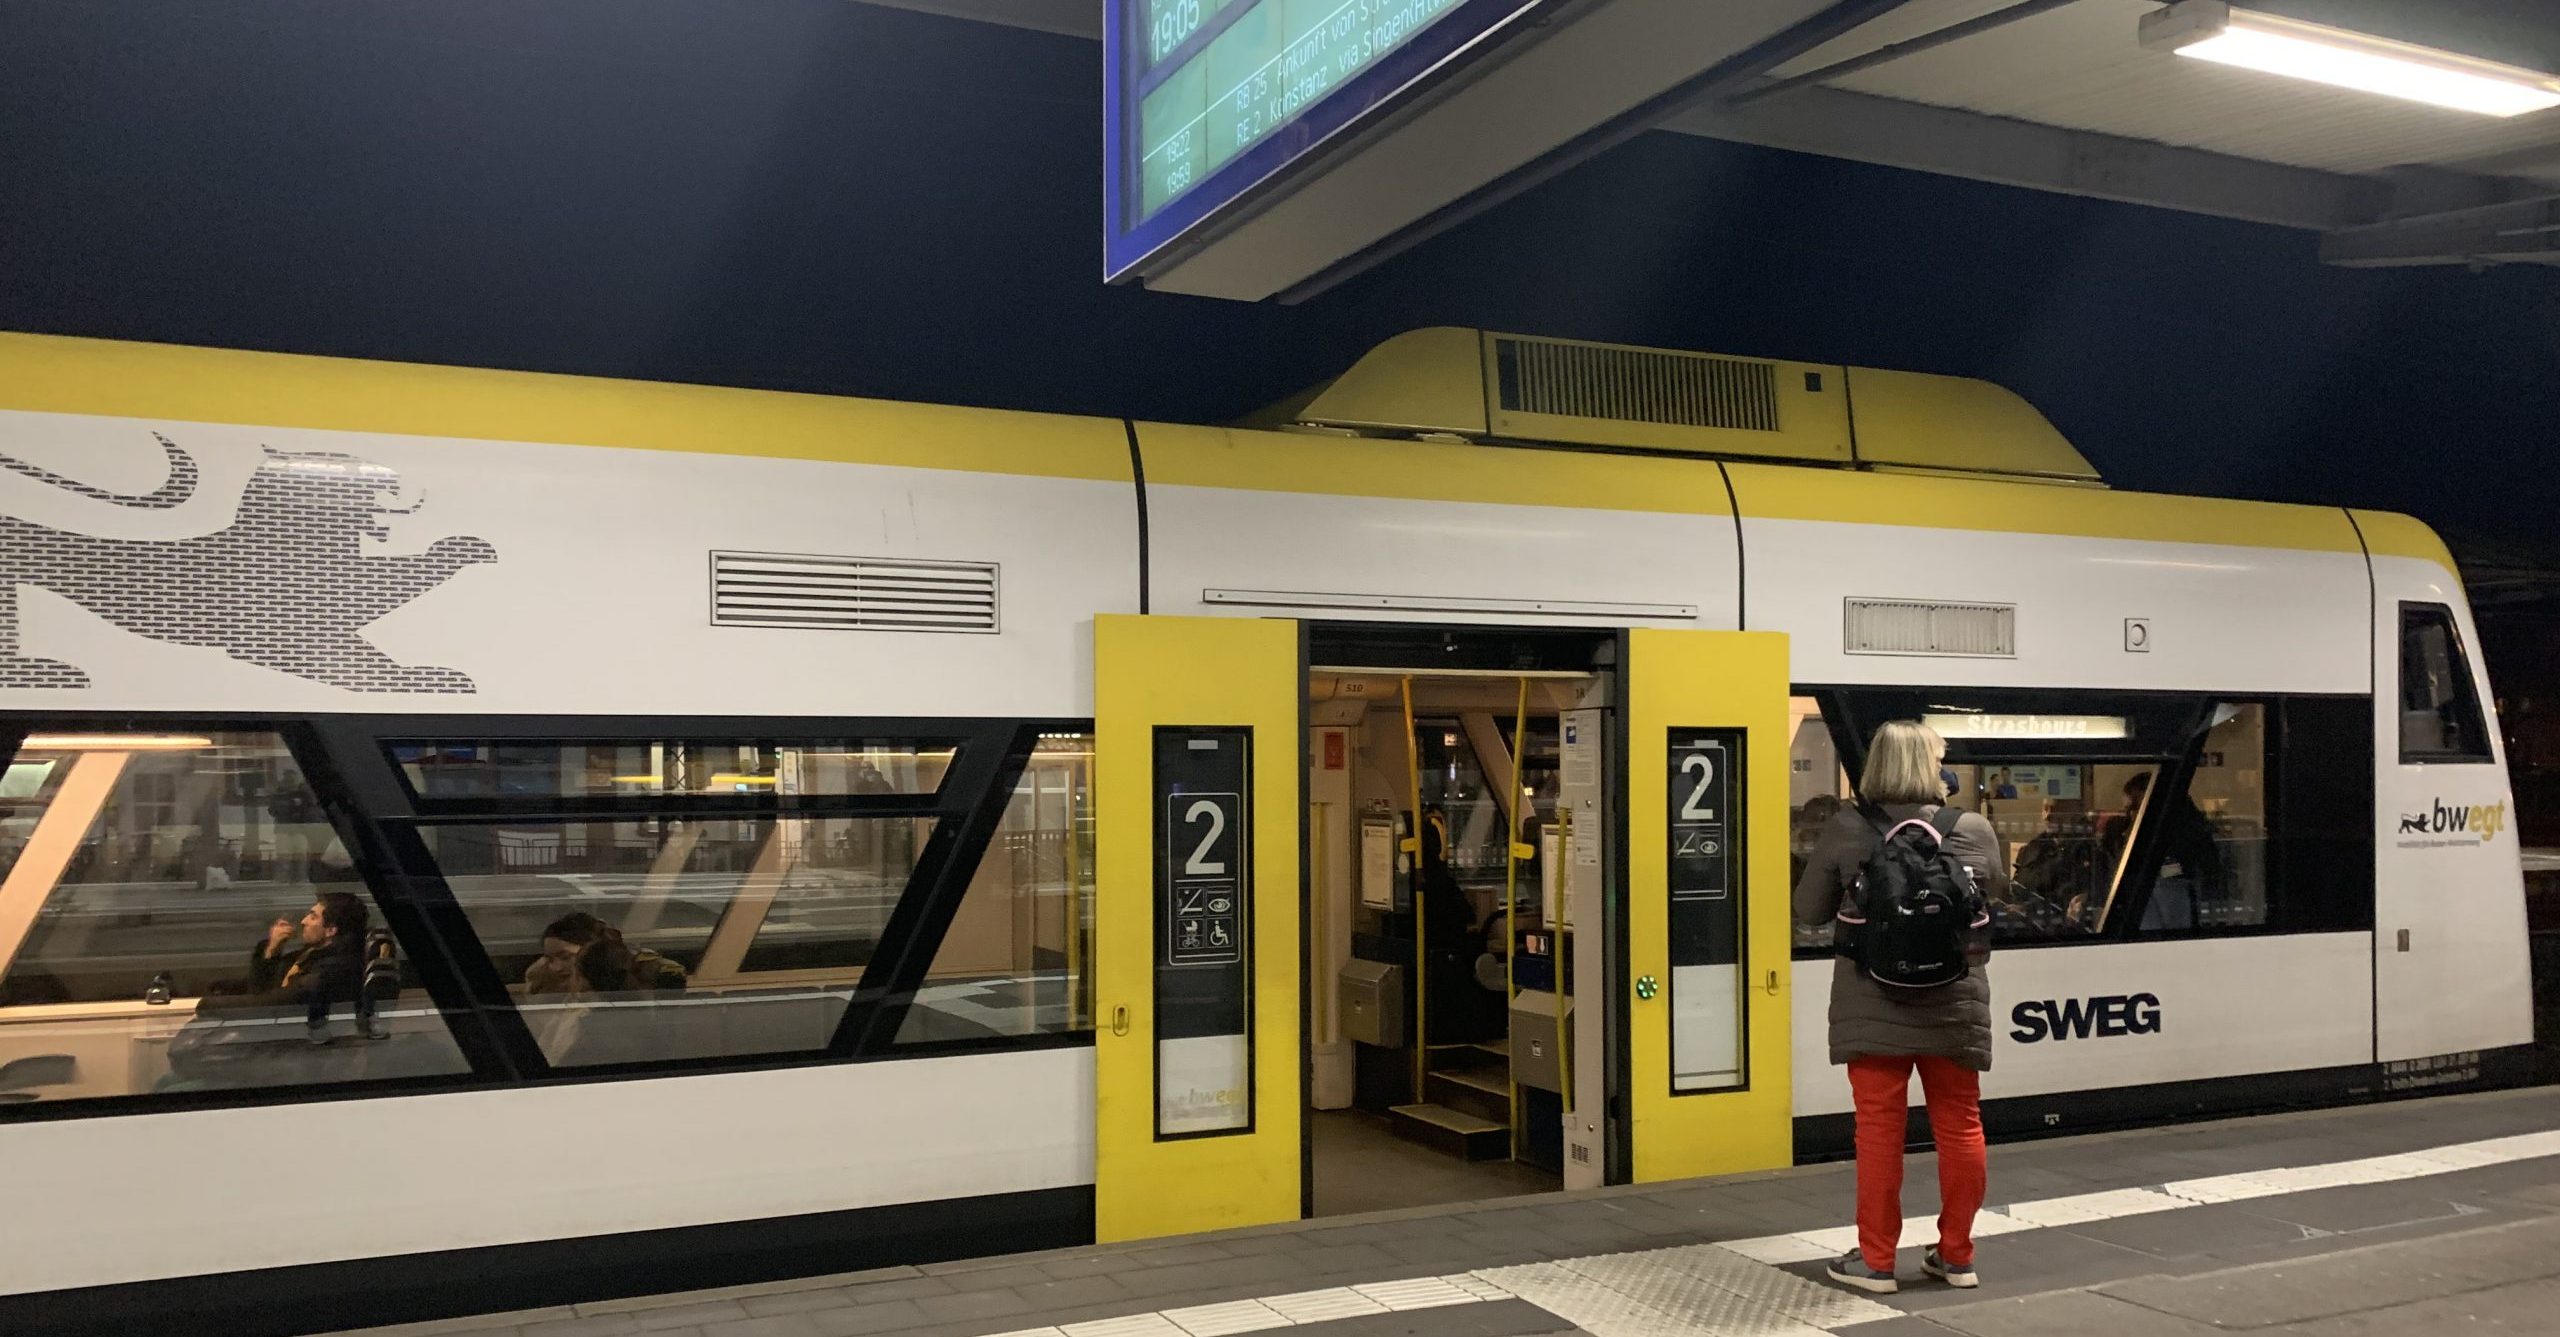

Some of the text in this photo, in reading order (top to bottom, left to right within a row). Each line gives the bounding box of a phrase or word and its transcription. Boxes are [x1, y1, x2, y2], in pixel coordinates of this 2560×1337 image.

[1152, 0, 1200, 61] 19:05
[1167, 131, 1191, 164] 19:22
[1236, 85, 1250, 113] RB
[1254, 72, 1268, 101] 25
[1276, 28, 1328, 85] Ankunft
[1332, 9, 1356, 42] von
[1167, 162, 1191, 196] 19:59
[1237, 118, 1250, 147] RE
[1254, 111, 1261, 135] 2
[1270, 66, 1328, 123] Konstanz
[1339, 44, 1359, 73] via
[1967, 715, 2087, 736] Strasbourg
[1681, 753, 1714, 820] 2
[1184, 800, 1225, 875] 2
[2432, 796, 2505, 842] bwegt
[2009, 992, 2161, 1044] SWEG
